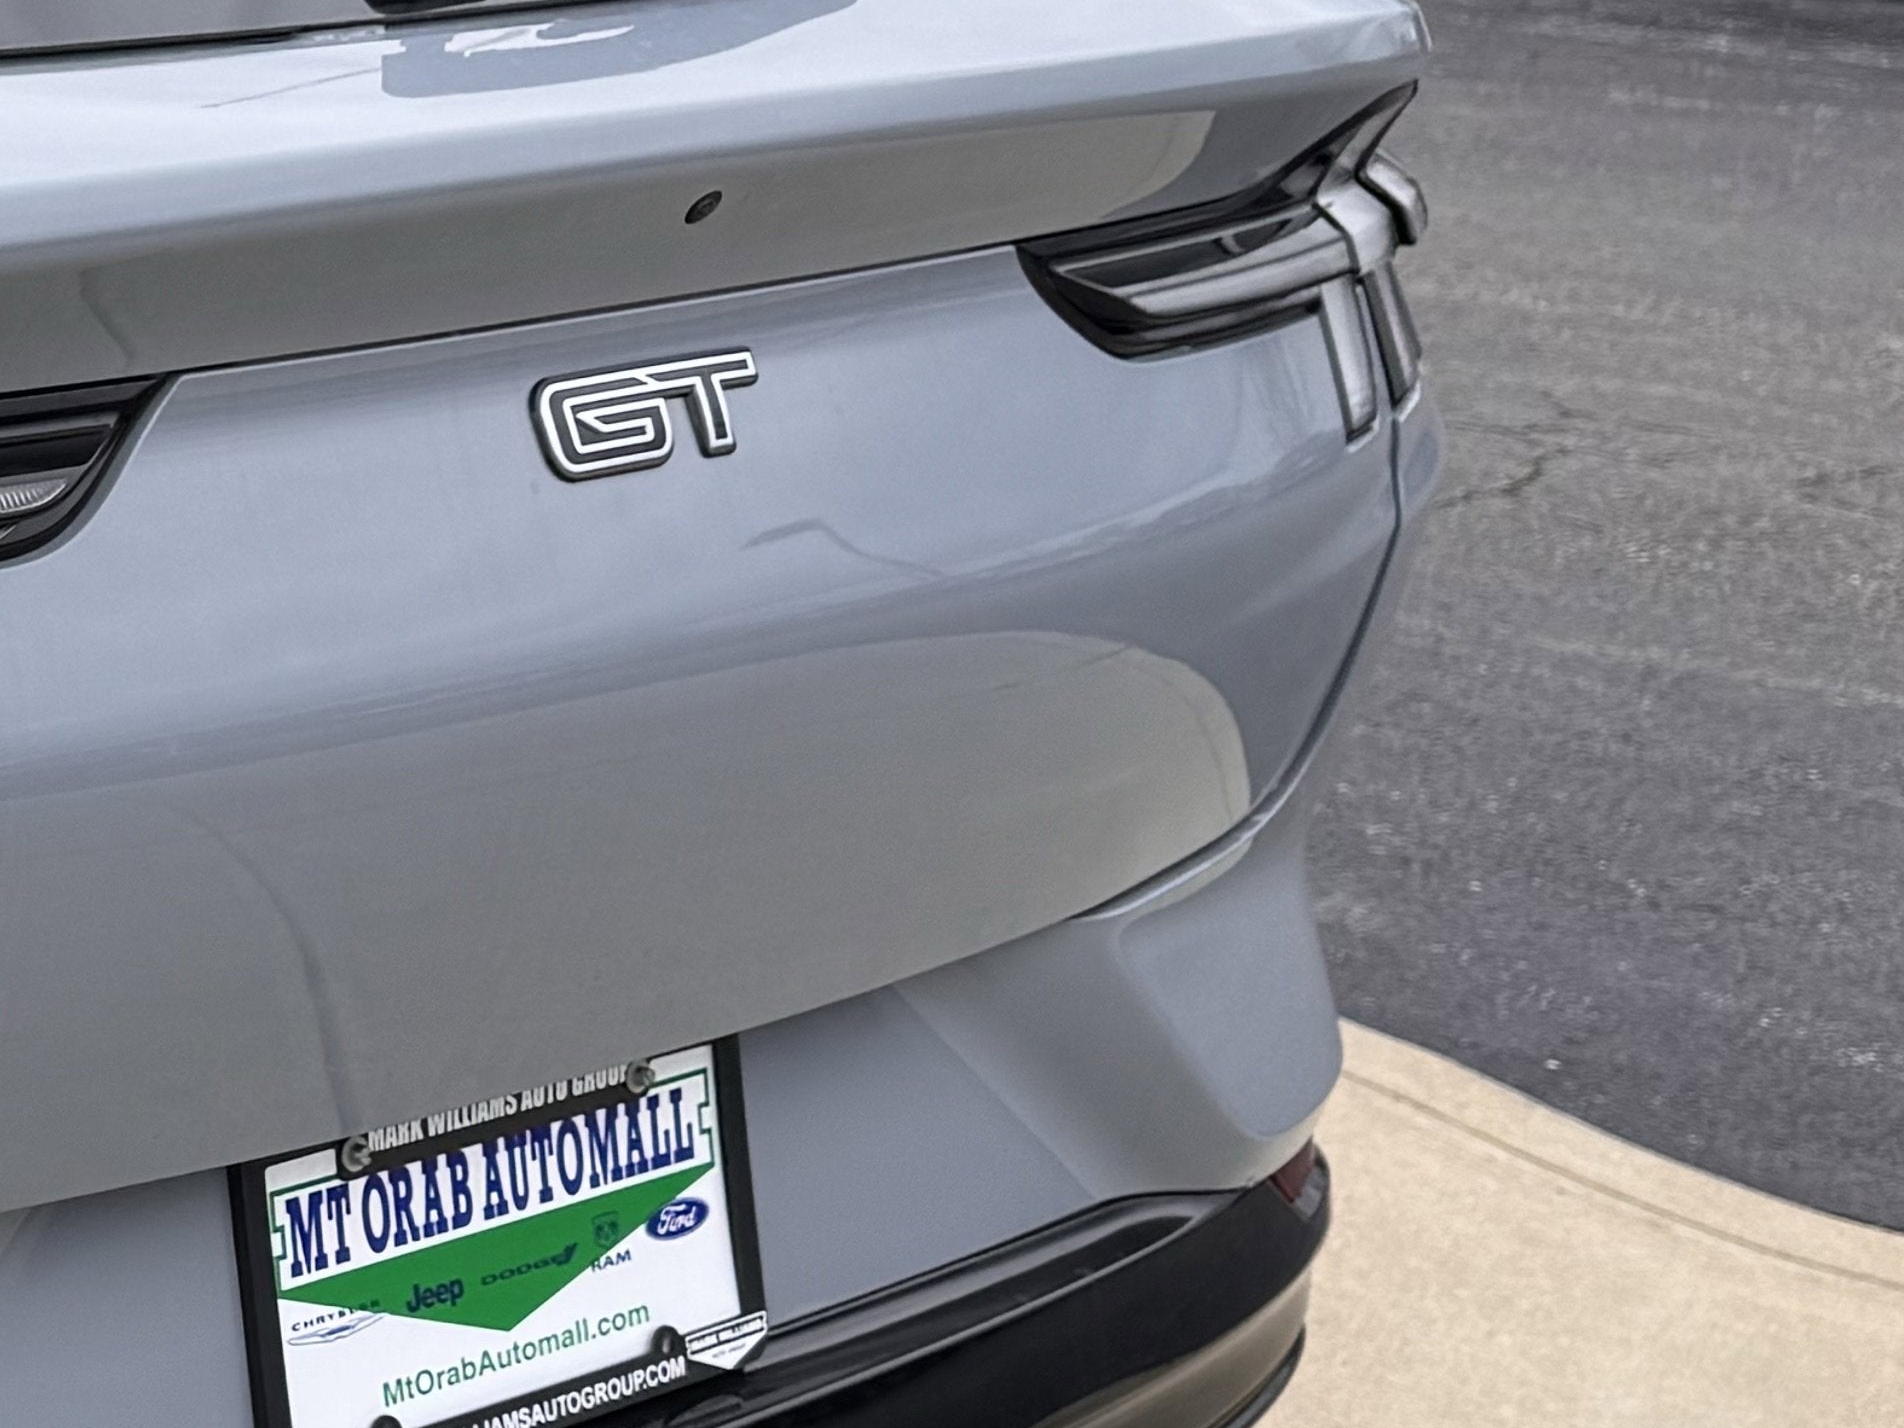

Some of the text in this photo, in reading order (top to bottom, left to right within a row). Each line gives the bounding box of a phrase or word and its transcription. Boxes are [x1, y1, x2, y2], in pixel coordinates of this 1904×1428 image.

[528, 346, 759, 483] GT
[368, 1118, 424, 1152] MARK
[427, 1093, 518, 1137] WILLIAMS
[520, 1079, 568, 1111] AUTO
[285, 1182, 352, 1278] MT
[361, 1153, 476, 1254] ORAB
[591, 1248, 632, 1272] RAM
[406, 1276, 465, 1314] Jeep
[382, 1300, 651, 1408] MtOrabAutomall.com
